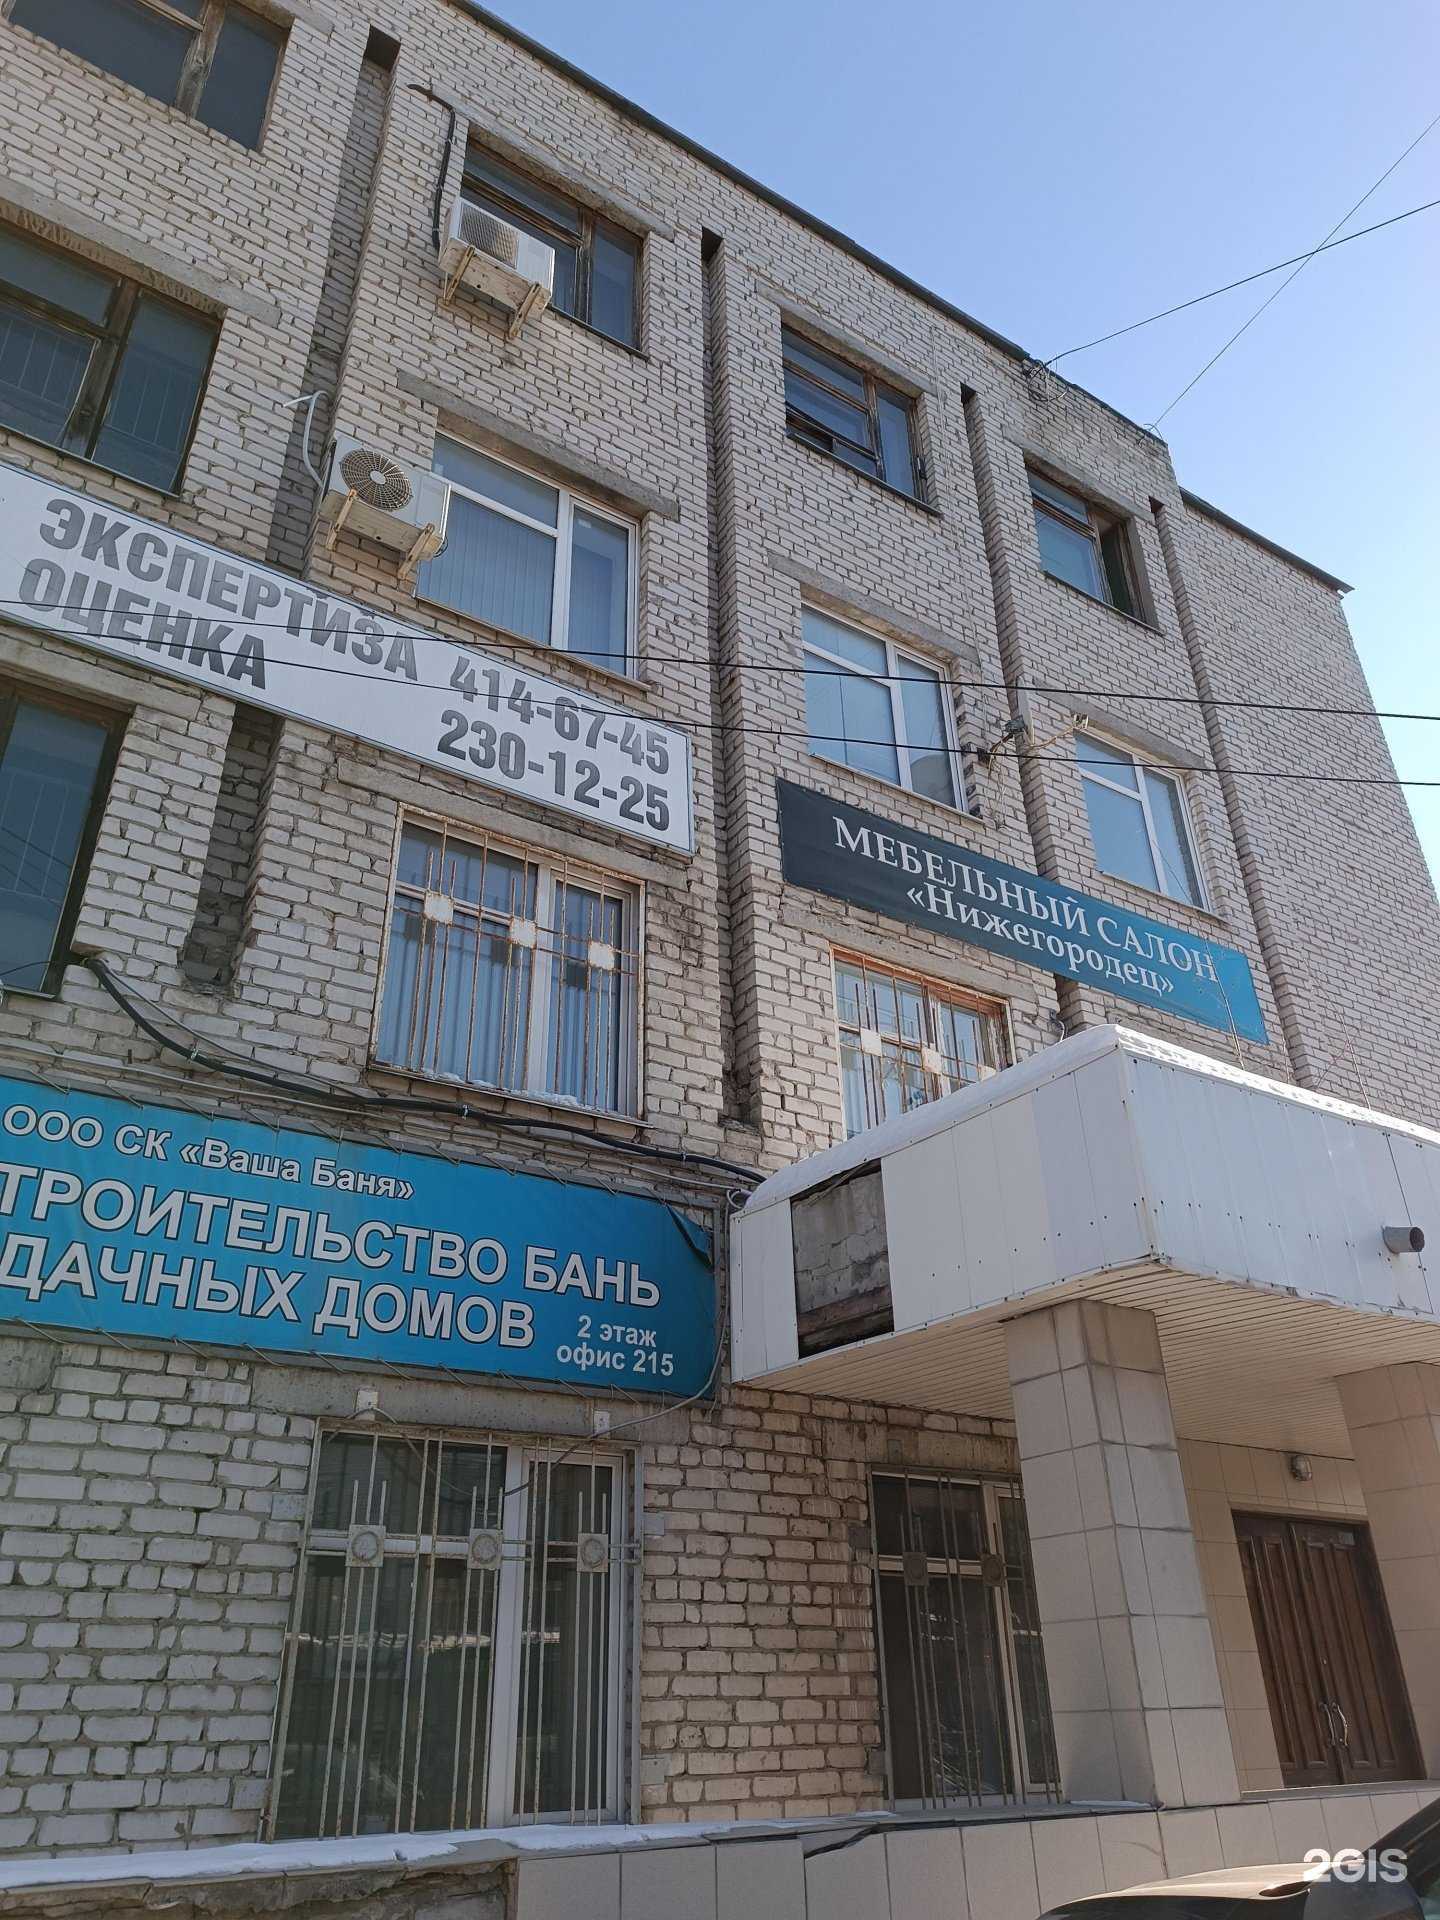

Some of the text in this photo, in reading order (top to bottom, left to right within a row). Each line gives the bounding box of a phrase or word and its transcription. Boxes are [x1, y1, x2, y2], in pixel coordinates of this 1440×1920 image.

[18, 558, 669, 832] ОЦЕНКА 230-12-25
[39, 498, 669, 775] ЭКСПЕРТИЗА 414-67-45
[832, 816, 1218, 983] МЕБЕЛЬНЫЙ САЛОН
[906, 882, 1174, 997] «Нижегородец»
[3, 1104, 415, 1200] ООО СК «Ваша Баня»
[0, 1161, 661, 1308] ТРОИТЕЛЬСТВО БАНЬ
[0, 1232, 536, 1349] ДАЧНЫХ ДОМОВ
[556, 1341, 674, 1376] офис 215
[577, 1314, 657, 1348] 2 этаж
